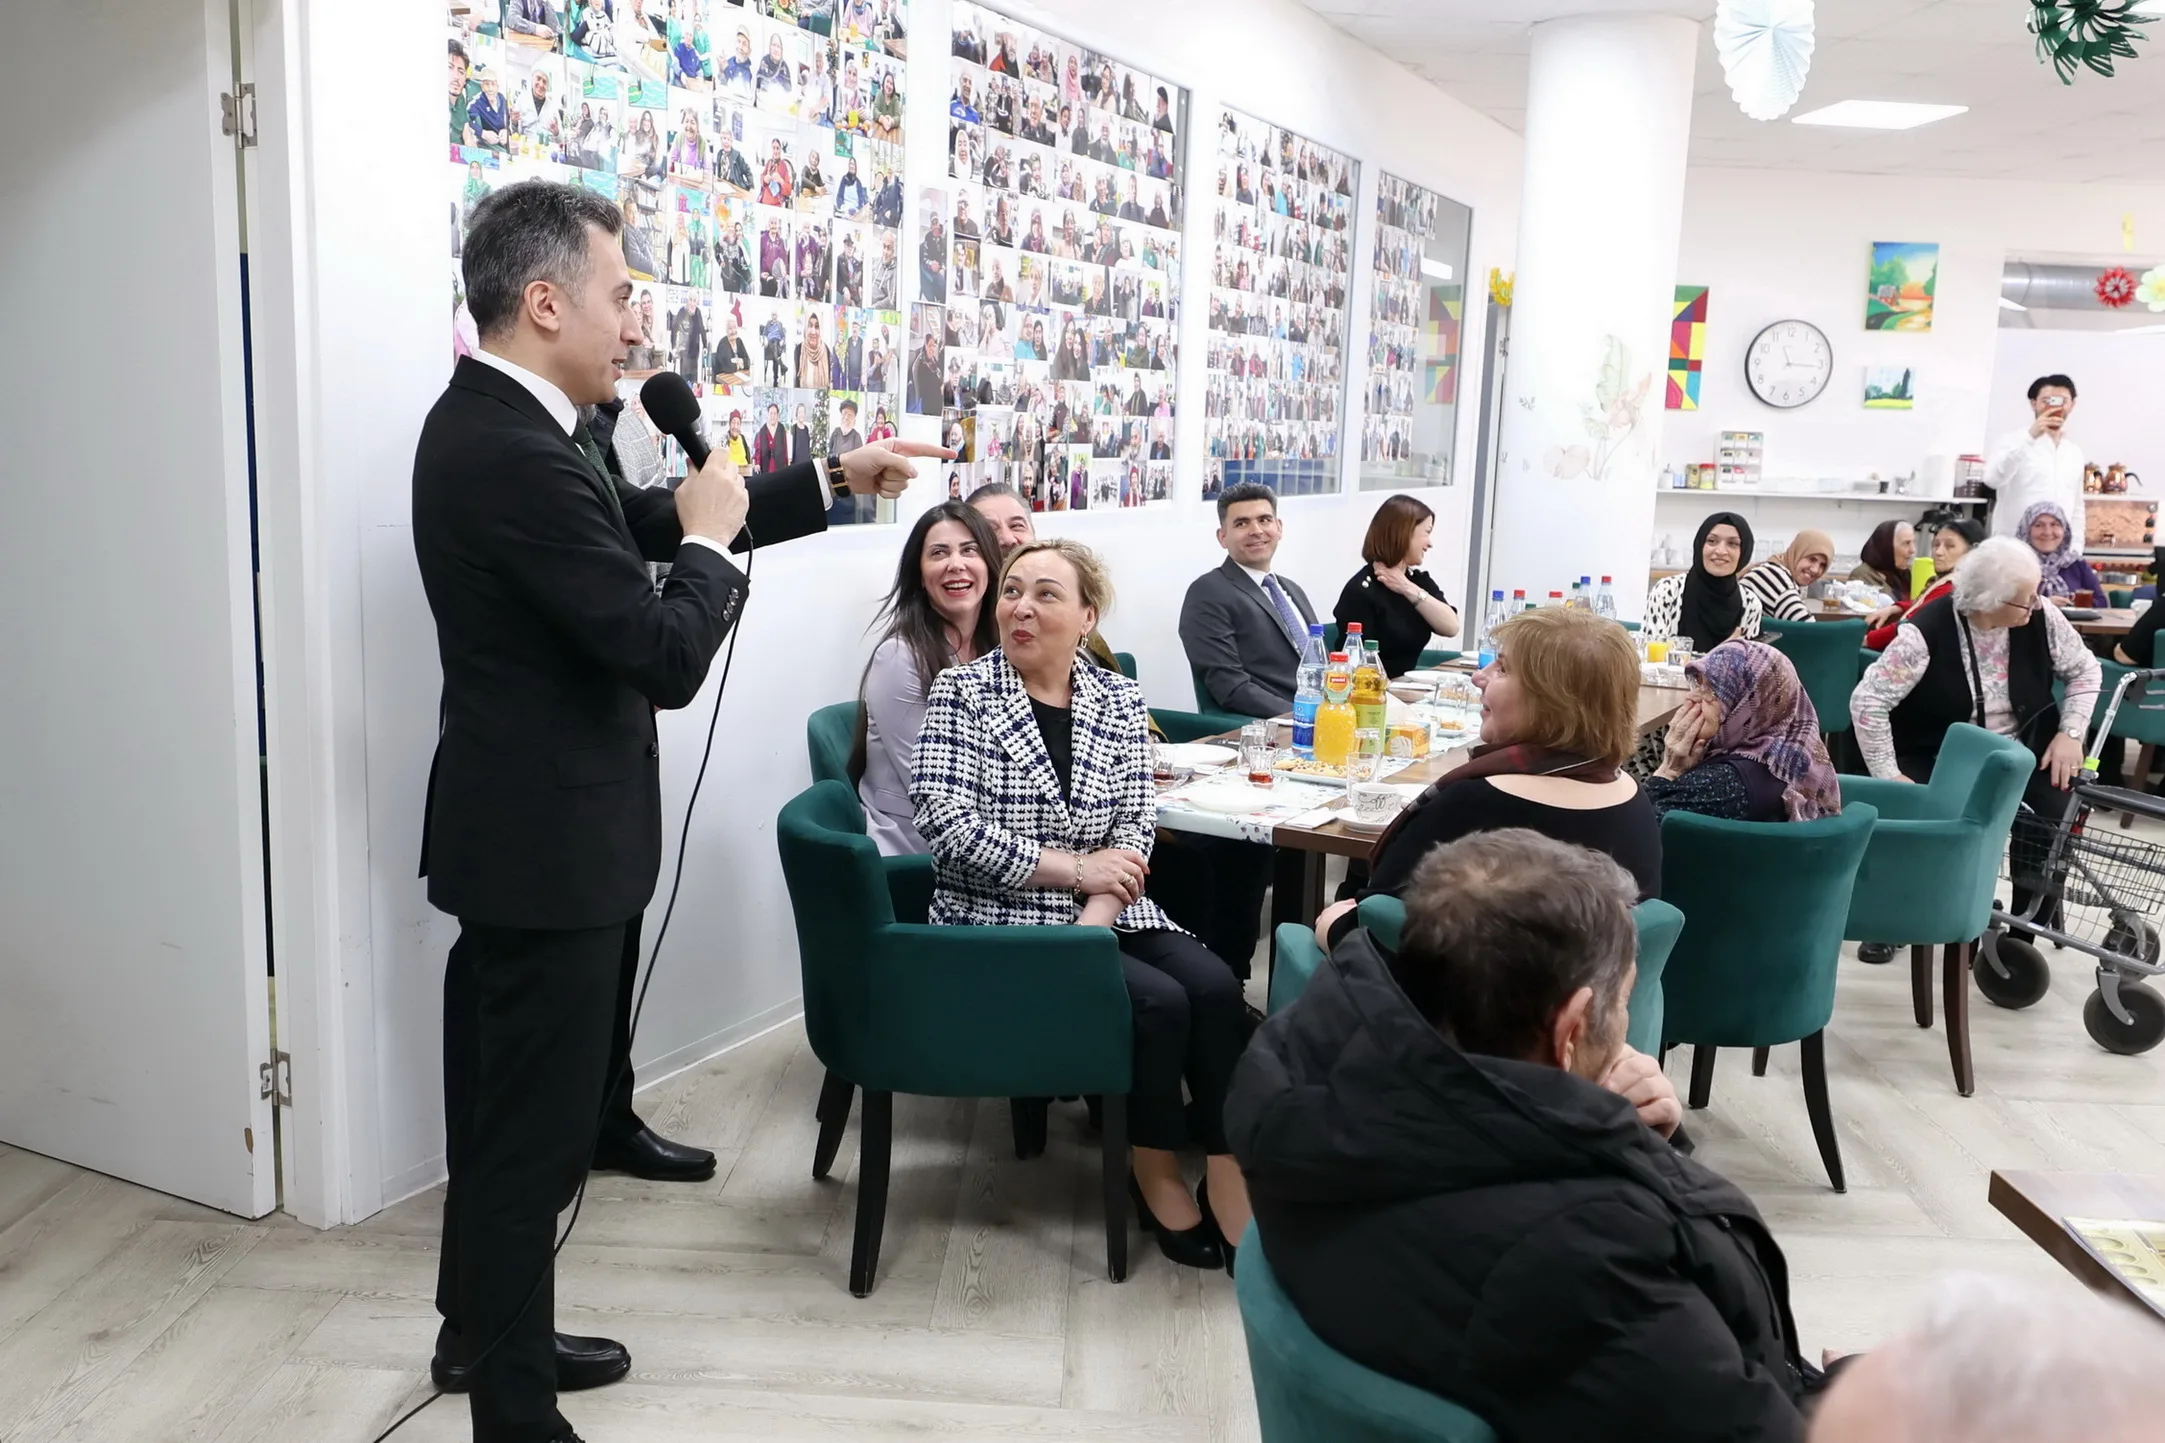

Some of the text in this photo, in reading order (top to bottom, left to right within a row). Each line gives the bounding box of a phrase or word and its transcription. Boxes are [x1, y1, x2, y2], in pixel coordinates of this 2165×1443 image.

[1773, 331, 1779, 342] 11
[1787, 327, 1797, 338] 12
[1805, 331, 1809, 342] 1
[1760, 343, 1771, 353] 10
[1814, 342, 1820, 353] 2
[1754, 357, 1761, 368] 9
[1817, 359, 1824, 370] 3
[1757, 374, 1764, 384] 8
[1810, 376, 1817, 385] 4
[1769, 385, 1776, 396] 7
[1782, 391, 1790, 401] 6
[1799, 386, 1806, 397] 5
